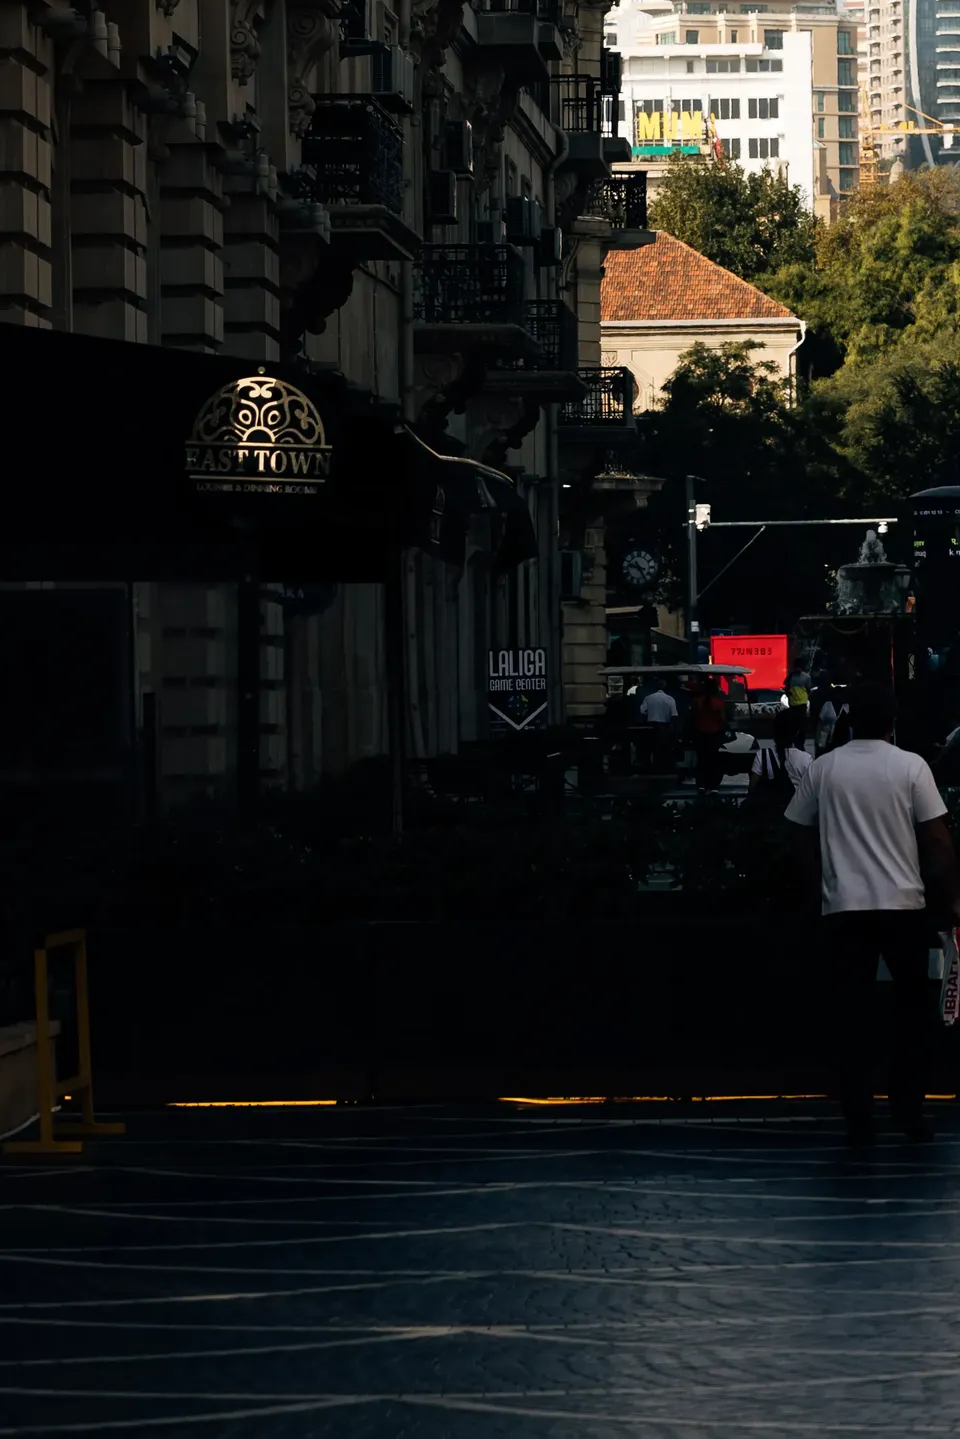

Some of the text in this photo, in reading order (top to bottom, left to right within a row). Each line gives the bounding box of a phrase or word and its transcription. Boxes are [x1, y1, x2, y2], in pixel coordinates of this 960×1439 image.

[184, 447, 332, 475] EAST TOWN
[489, 649, 546, 677] LALIGA
[490, 677, 546, 692] GAME CENTER
